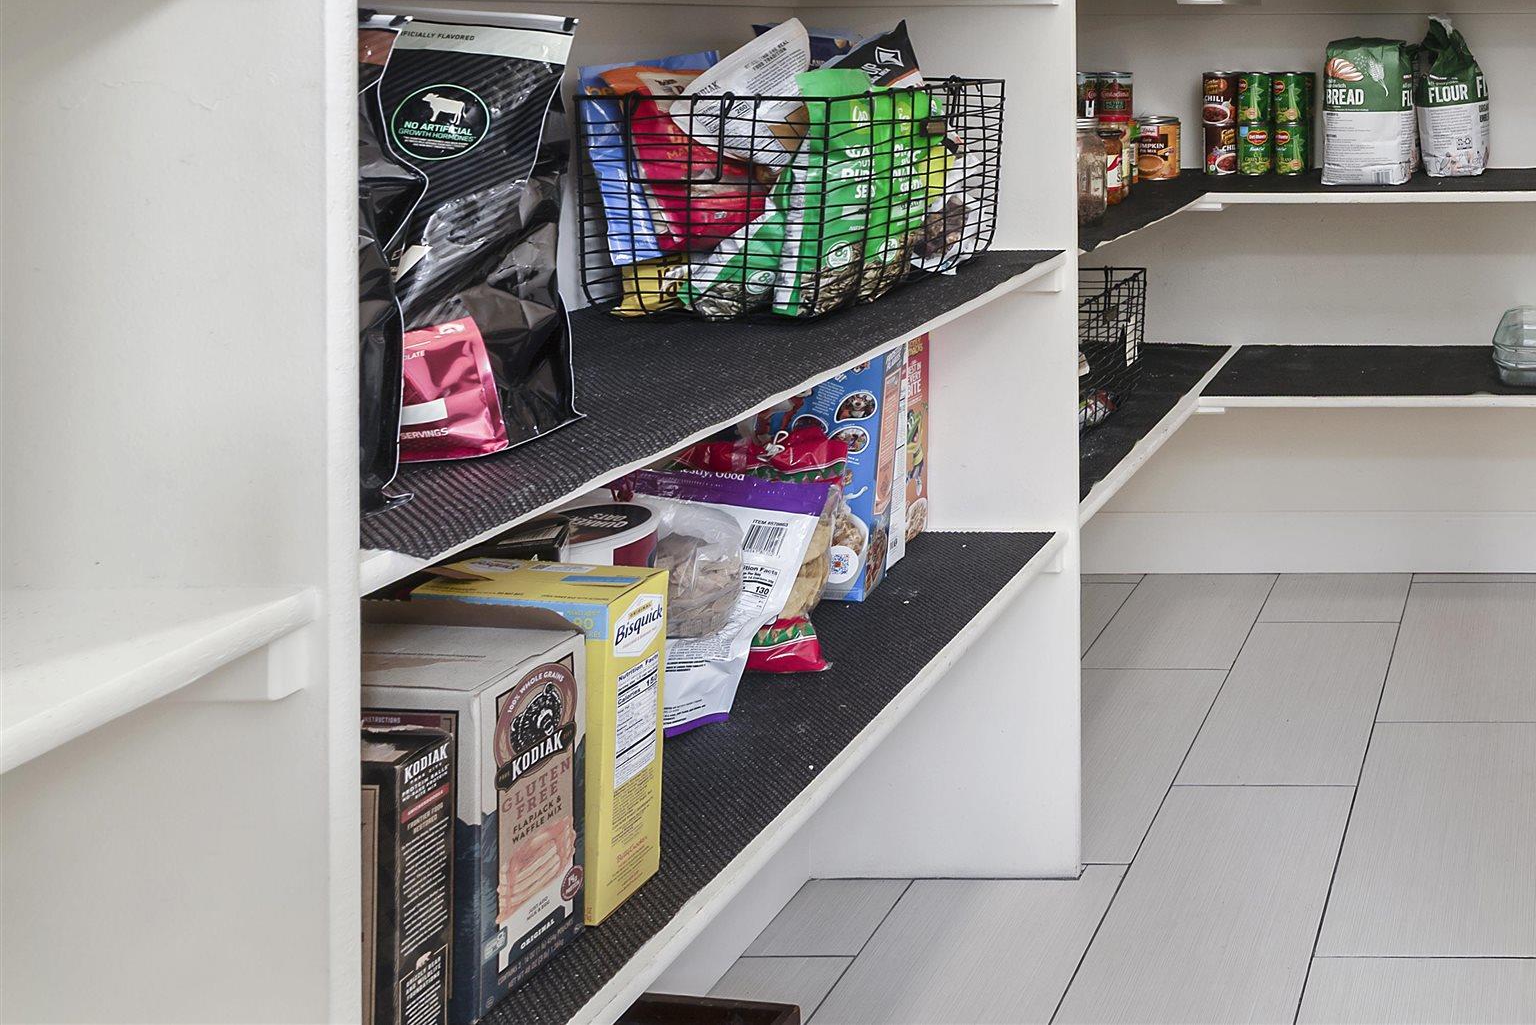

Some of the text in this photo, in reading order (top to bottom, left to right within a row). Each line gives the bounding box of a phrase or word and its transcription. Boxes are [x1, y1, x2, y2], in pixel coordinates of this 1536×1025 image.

[400, 31, 475, 41] IFICIALLY FLAVORED
[1204, 95, 1224, 103] CHILI
[1325, 88, 1365, 106] BREAD
[1428, 84, 1469, 104] FLOUR
[734, 104, 749, 115] 260
[398, 128, 432, 138] GROWTH
[404, 120, 473, 136] NO ARTIFICIAL
[401, 427, 449, 440] SERVINGS
[588, 513, 628, 522] OATS
[754, 585, 770, 596] 130
[614, 604, 664, 648] Bisquick
[618, 663, 644, 682] Nutrition
[507, 669, 566, 714] 100% WHOLE GRAINS
[617, 688, 641, 706] Calories
[404, 742, 450, 784] KODIAK
[511, 728, 564, 782] KODIAK
[501, 756, 572, 814] GLUTEN
[516, 781, 559, 821] FREE
[512, 798, 555, 835] FLAPJACK
[512, 805, 563, 845] WAFFLE MIX
[520, 918, 555, 950] ORIGINAL
